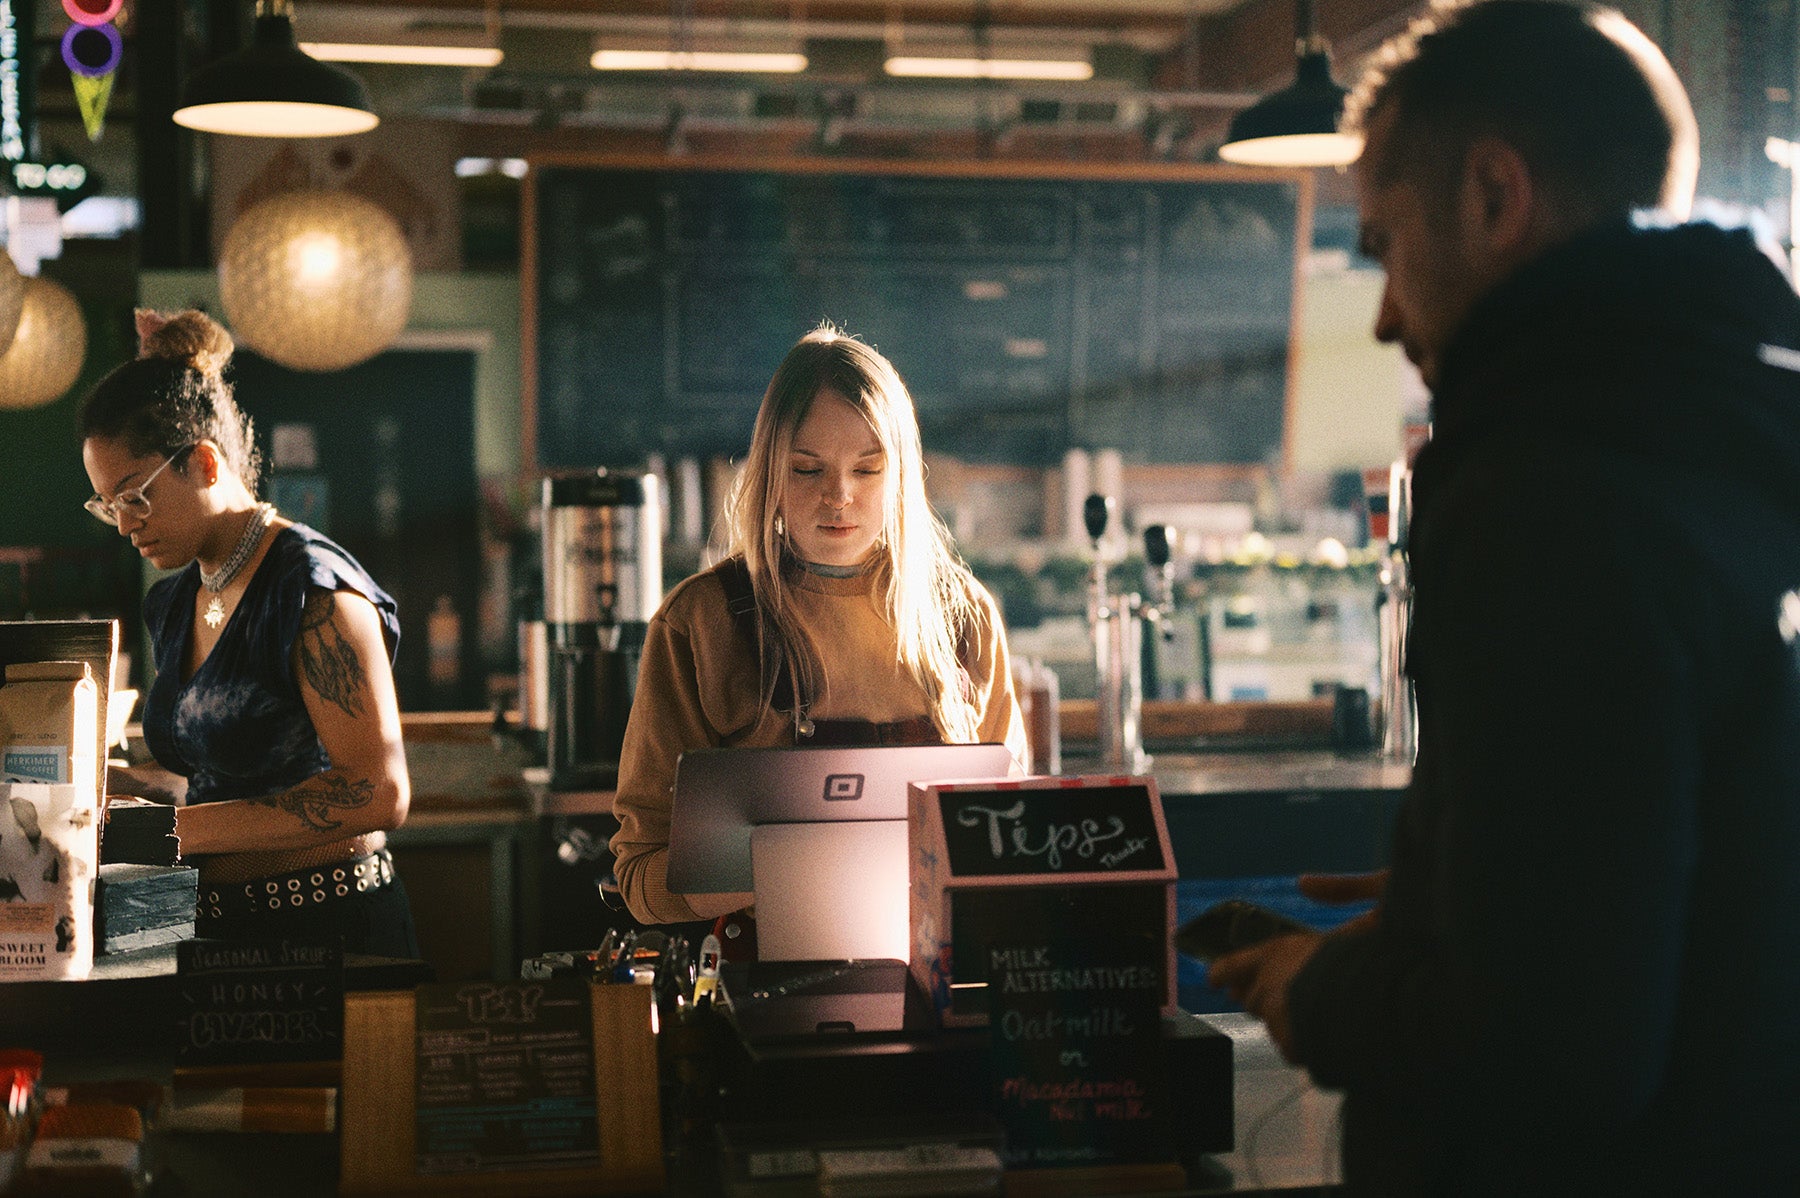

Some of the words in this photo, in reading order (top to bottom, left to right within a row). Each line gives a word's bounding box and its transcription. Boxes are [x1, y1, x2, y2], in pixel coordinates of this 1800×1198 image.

[7, 757, 55, 766] HERKIMER
[957, 800, 1125, 869] Tips
[991, 946, 1050, 970] MILK
[211, 982, 305, 1004] HONEY
